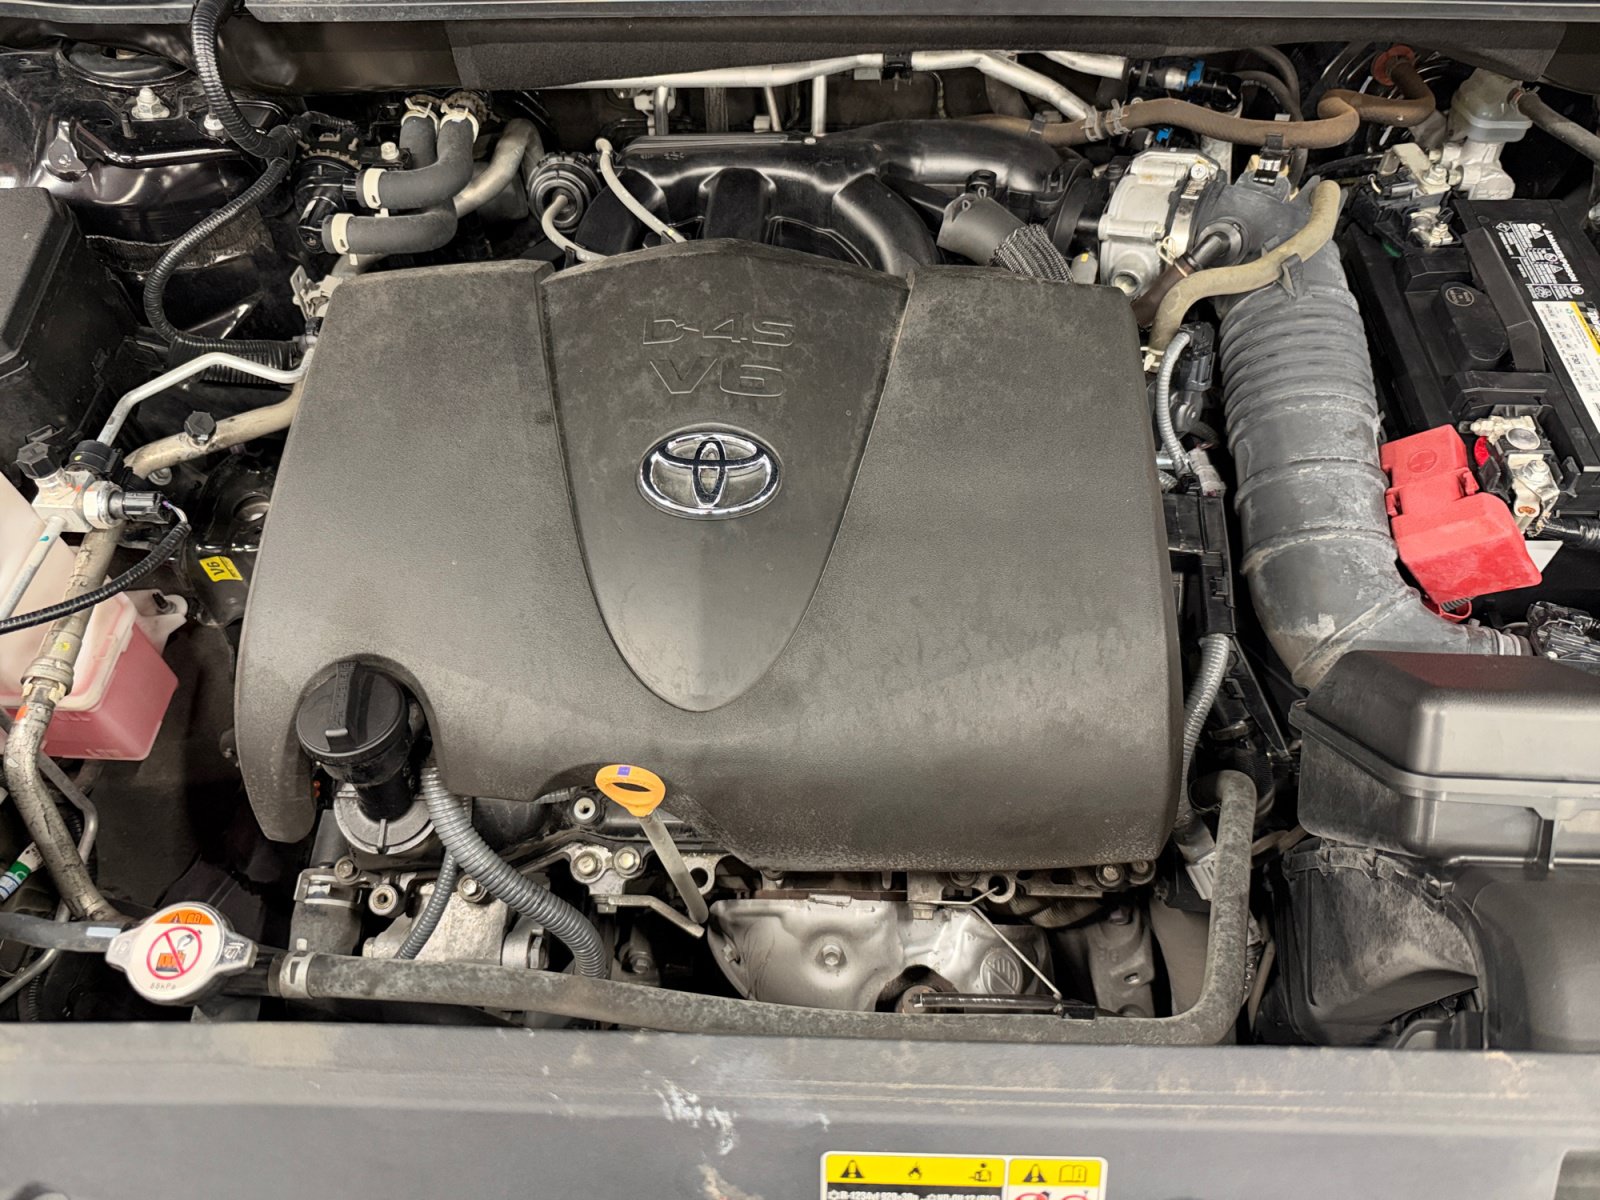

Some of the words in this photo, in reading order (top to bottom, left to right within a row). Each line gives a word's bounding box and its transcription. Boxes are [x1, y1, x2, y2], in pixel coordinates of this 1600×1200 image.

[643, 312, 795, 347] D-4S
[649, 354, 785, 397] V6
[206, 561, 225, 576] V6
